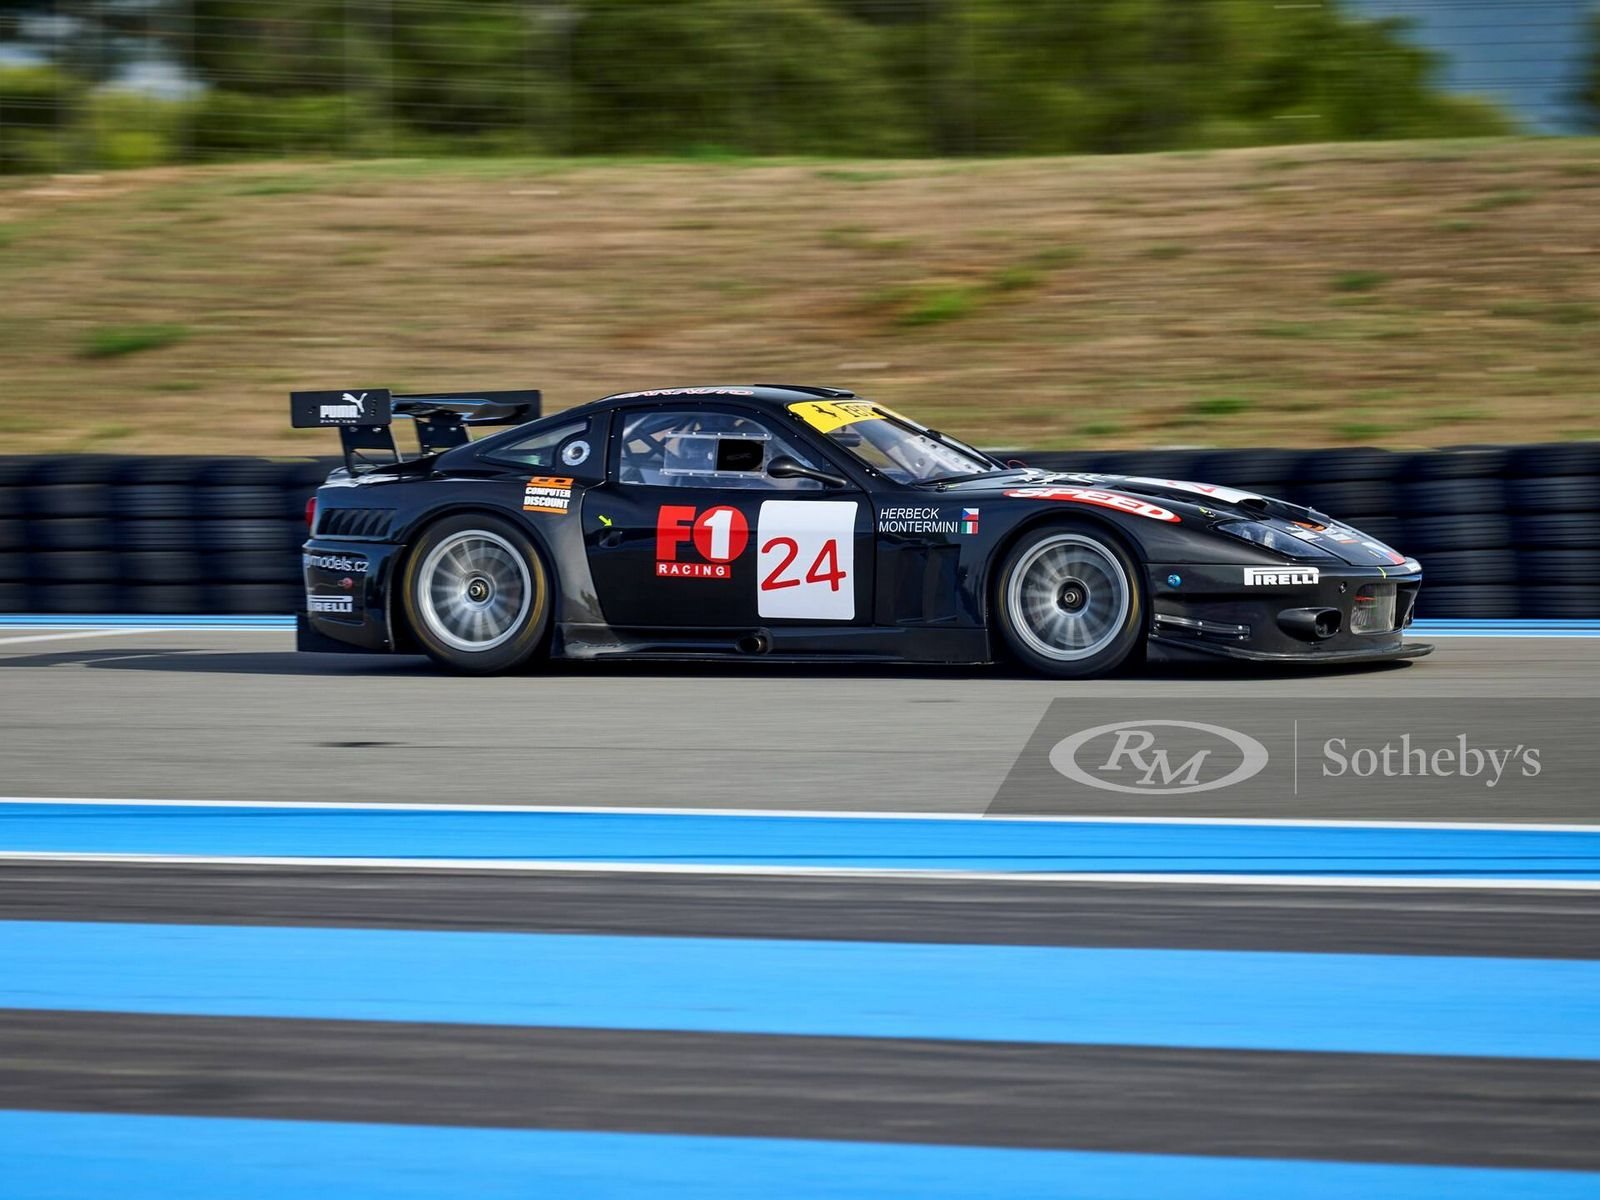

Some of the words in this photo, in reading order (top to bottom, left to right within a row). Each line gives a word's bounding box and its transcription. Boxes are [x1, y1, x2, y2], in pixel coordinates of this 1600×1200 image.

[525, 487, 571, 498] COMPUTER
[523, 495, 570, 509] DISCOUNT
[1007, 488, 1178, 520] SPEED
[879, 507, 940, 519] HERBECK
[656, 505, 734, 561] F1
[878, 521, 958, 533] MONTERMINI
[658, 564, 725, 577] RACING
[761, 537, 847, 592] 24
[1244, 567, 1319, 586] PIRELLI
